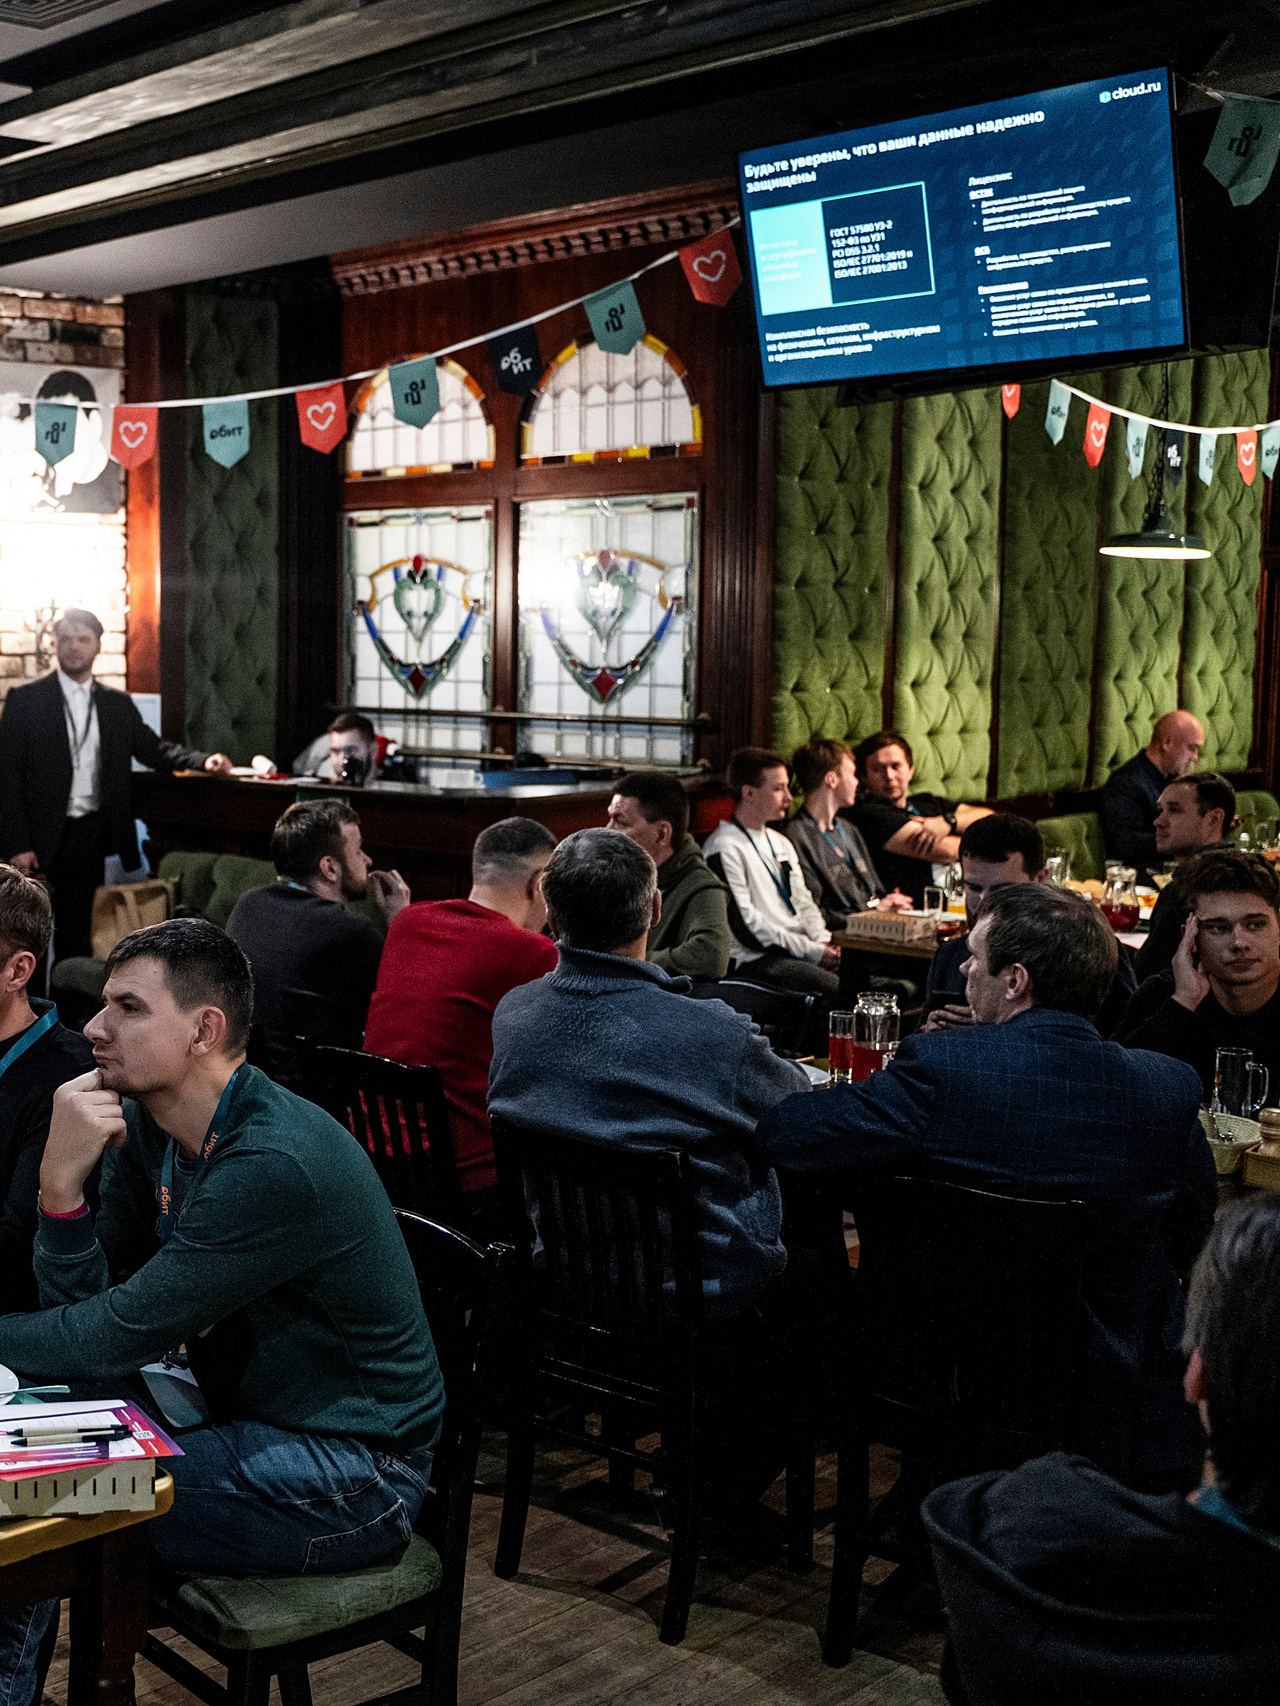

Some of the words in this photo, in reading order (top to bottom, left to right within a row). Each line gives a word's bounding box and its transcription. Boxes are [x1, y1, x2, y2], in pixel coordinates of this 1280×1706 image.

[1112, 82, 1161, 99] cloud.ru
[744, 160, 788, 178] Будьте
[789, 148, 851, 171] уверены,
[852, 143, 876, 156] что
[878, 135, 916, 152] ваши
[918, 124, 974, 147] данные
[975, 110, 1044, 133] надежно
[746, 171, 816, 193] защищены
[829, 226, 848, 237] ГОСТ
[209, 425, 243, 440] обит
[161, 1186, 171, 1216] обит
